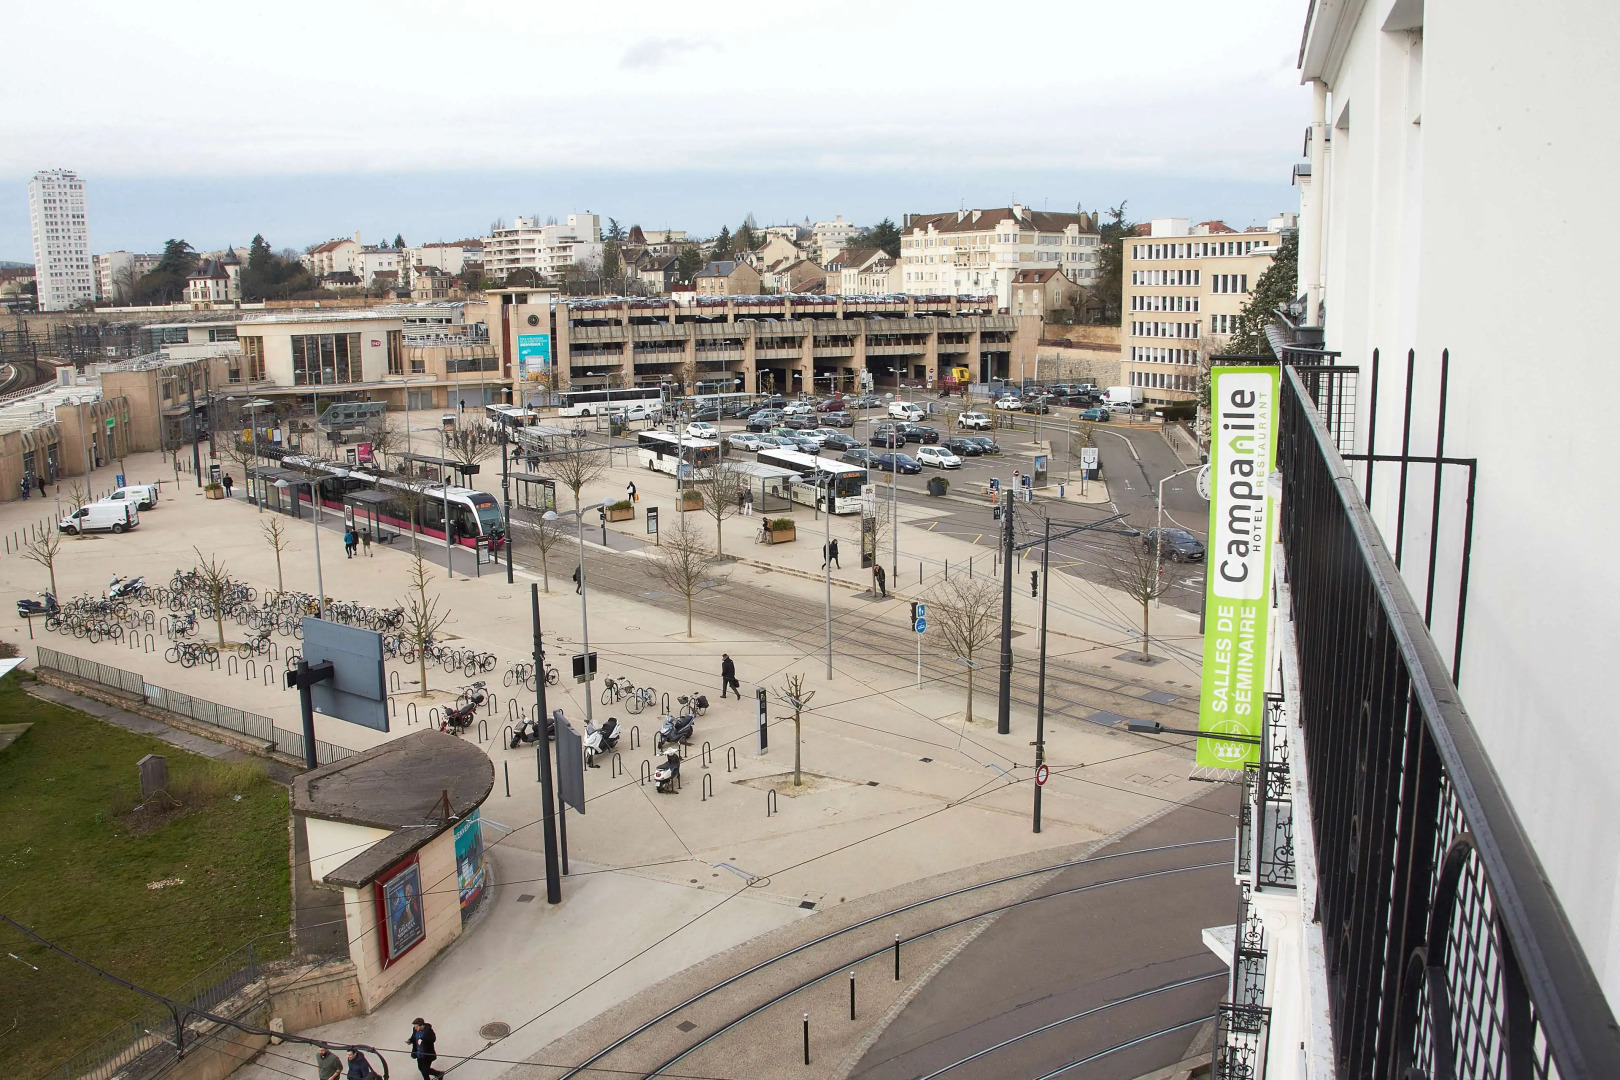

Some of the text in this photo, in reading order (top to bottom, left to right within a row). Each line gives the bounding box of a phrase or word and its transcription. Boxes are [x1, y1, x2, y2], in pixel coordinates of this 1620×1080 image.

[1220, 389, 1264, 583] Campanile
[1252, 392, 1268, 552] HOTEL RESTAURANT
[1212, 605, 1234, 713] SALLES DE
[1231, 606, 1256, 716] SÉMINAIRE
